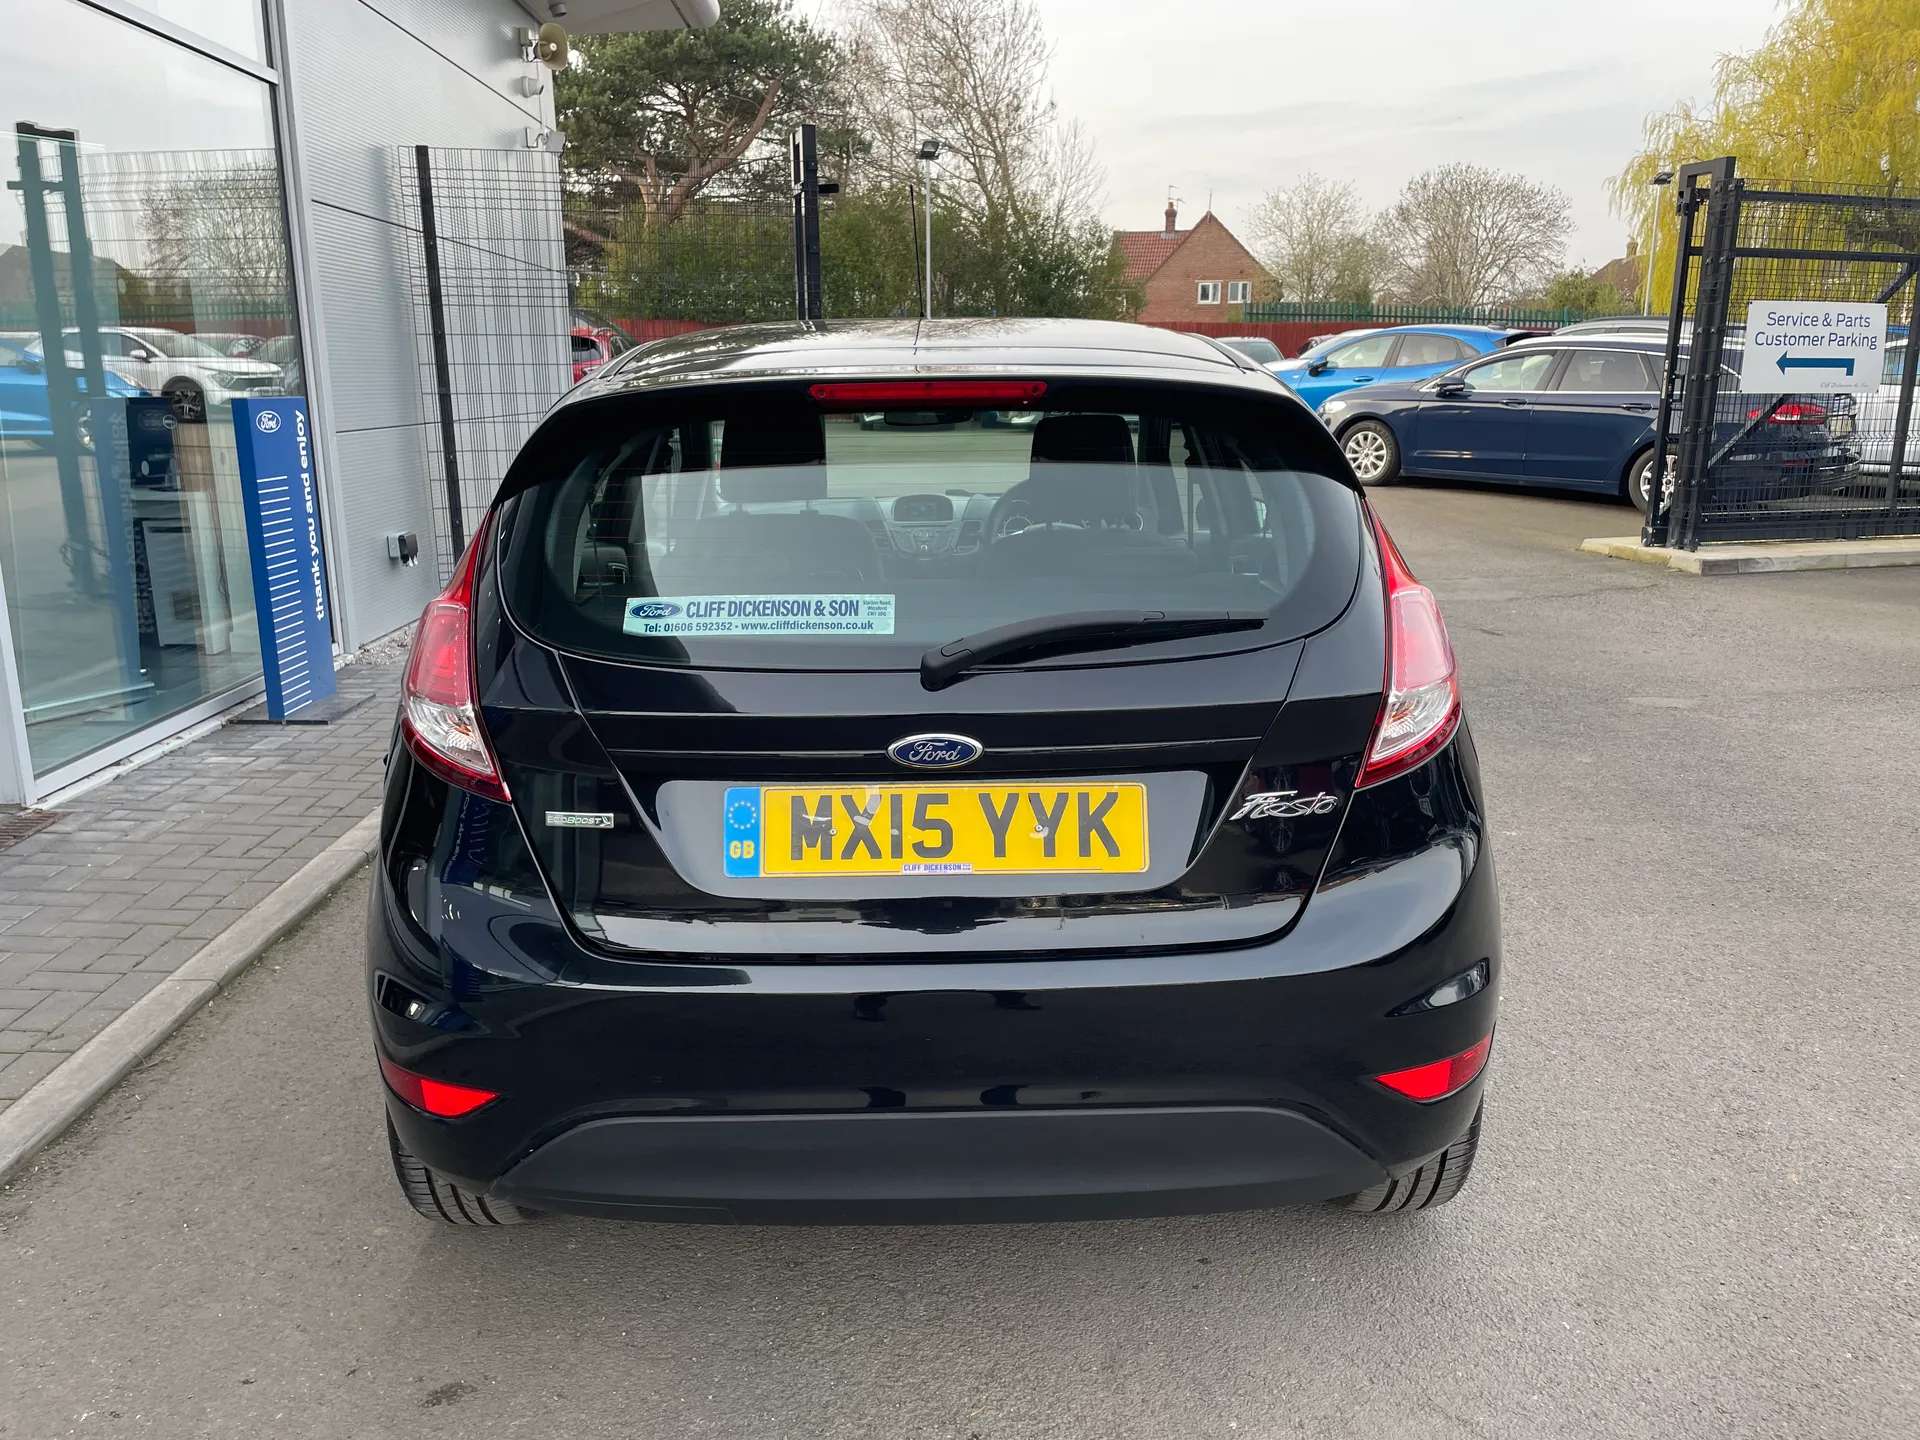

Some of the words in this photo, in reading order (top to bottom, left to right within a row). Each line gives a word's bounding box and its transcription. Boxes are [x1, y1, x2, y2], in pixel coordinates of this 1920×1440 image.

[1767, 311, 1819, 327] Service
[1822, 313, 1833, 327] &
[1836, 313, 1871, 328] Parts
[1755, 332, 1825, 347] Customer
[1828, 332, 1877, 350] Parking
[295, 409, 308, 469] enjoy
[301, 473, 313, 513] and
[308, 518, 319, 557] you
[312, 559, 325, 621] thank
[639, 604, 673, 617] Ford
[686, 601, 726, 618] CLIFF
[727, 600, 811, 618] DICKENSON
[813, 600, 827, 617] &
[829, 600, 860, 617] SON
[644, 623, 662, 633] Tel:
[664, 623, 693, 632] 01606
[697, 622, 733, 631] 592352
[741, 620, 874, 631] www.cliffdickenson.co.uk
[908, 741, 962, 761] Ford
[1229, 790, 1339, 821] Fiesta
[790, 793, 955, 861] MX15
[978, 792, 1121, 858] YYK
[729, 840, 755, 859] GB
[903, 864, 921, 872] CLIFF
